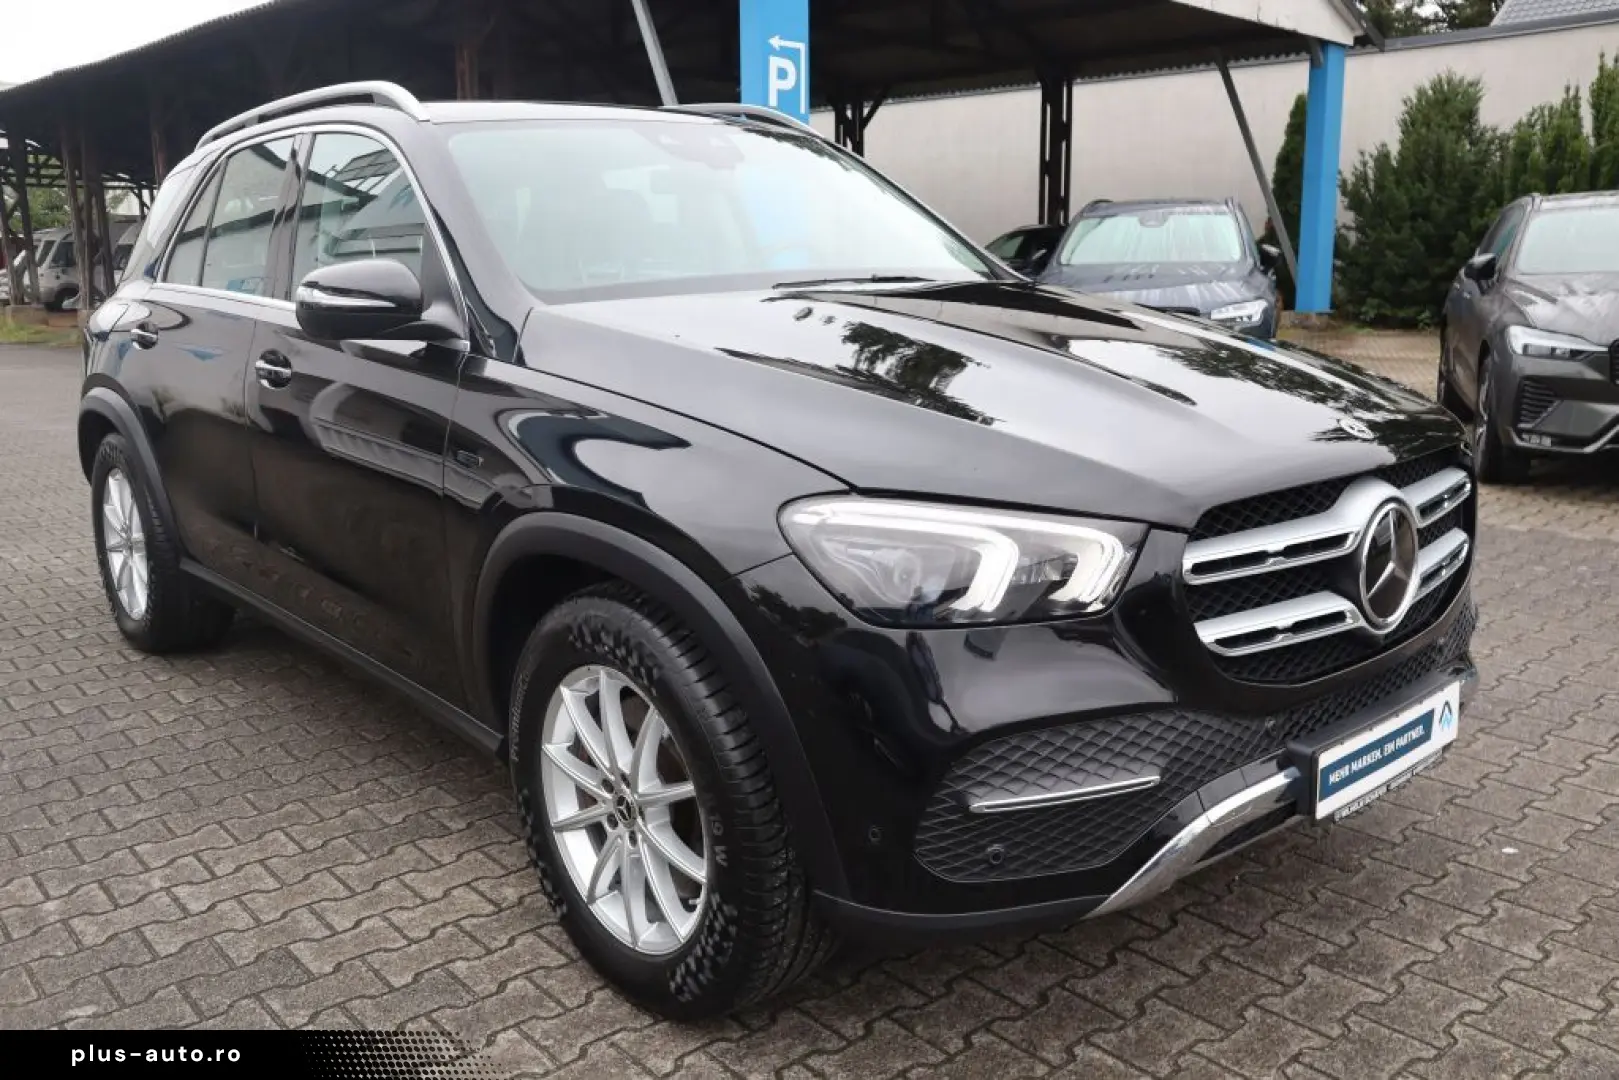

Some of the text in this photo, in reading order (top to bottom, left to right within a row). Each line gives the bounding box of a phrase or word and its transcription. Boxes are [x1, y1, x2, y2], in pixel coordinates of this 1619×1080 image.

[768, 55, 797, 107] P
[1328, 764, 1350, 786] MEHR
[1351, 747, 1382, 774] MARKEN.
[1384, 739, 1396, 757] EIN
